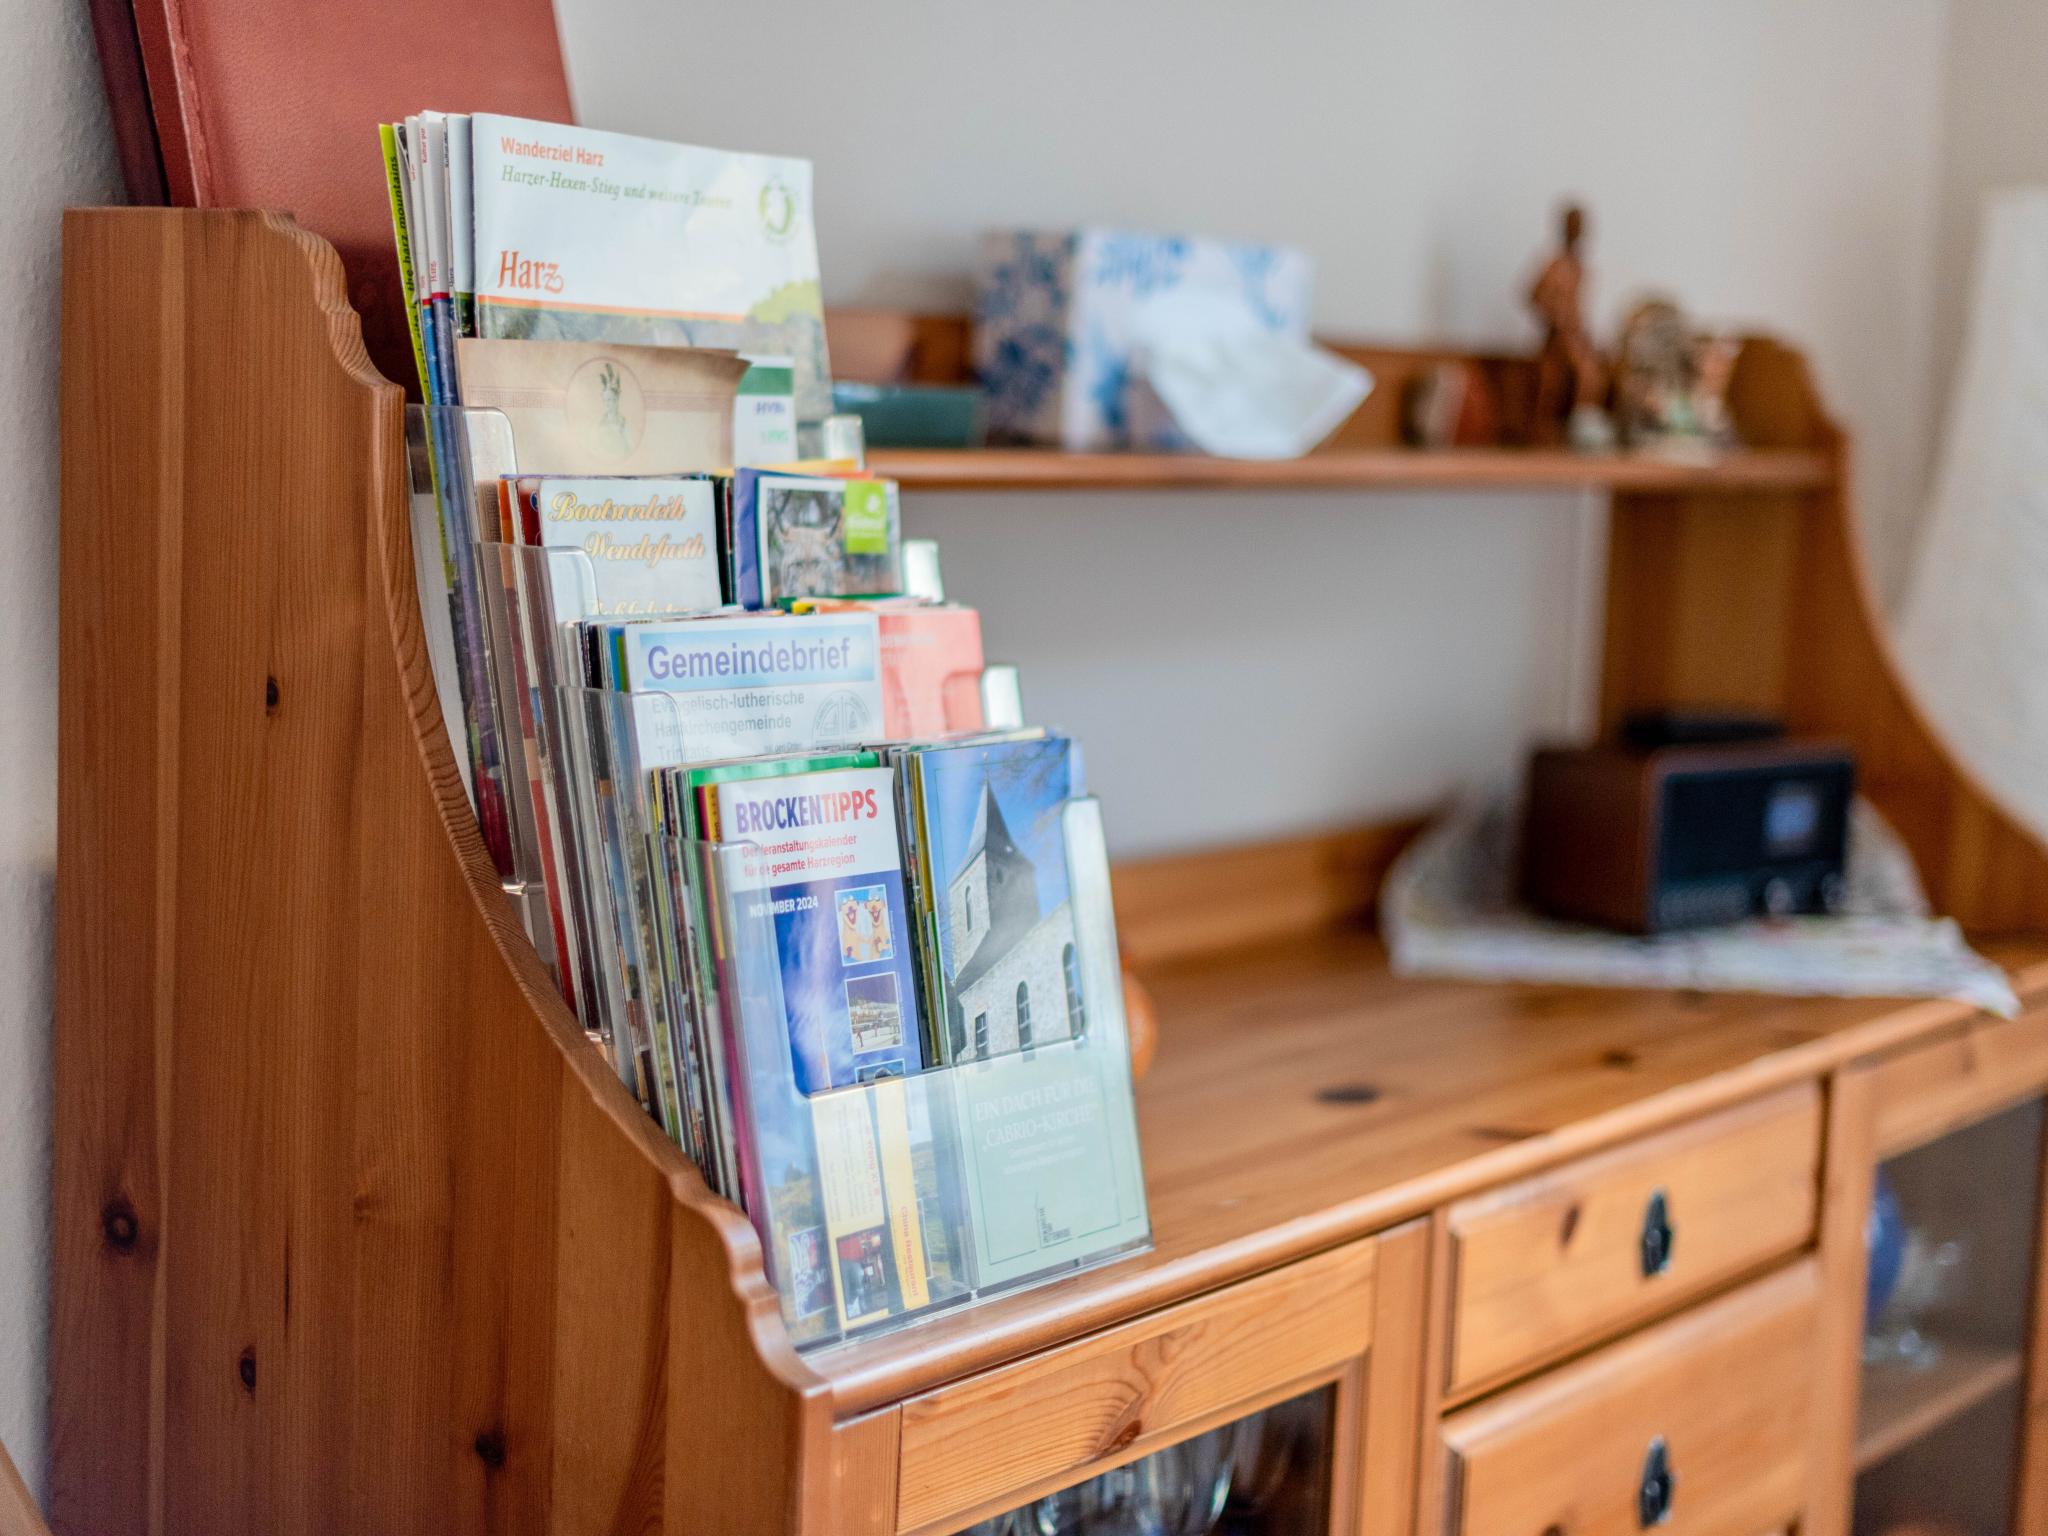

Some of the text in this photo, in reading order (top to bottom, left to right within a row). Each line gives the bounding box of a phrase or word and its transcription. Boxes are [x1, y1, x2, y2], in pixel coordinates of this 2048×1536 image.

[501, 136, 604, 167] Wanderziel Harz
[501, 164, 620, 200] Harzer-Hexen-Stieg
[624, 184, 647, 199] und
[390, 156, 414, 292] the harz mountains
[497, 250, 564, 294] Harz
[648, 637, 850, 680] Gemeindebrief
[655, 716, 792, 739] Harkirchengemeinde
[735, 788, 878, 834] BROCKENTIPPS
[759, 863, 770, 876] de
[771, 859, 806, 877] gesamte
[807, 852, 856, 869] Harzregion
[797, 895, 819, 912] 2024
[1002, 1087, 1043, 1116] DACH
